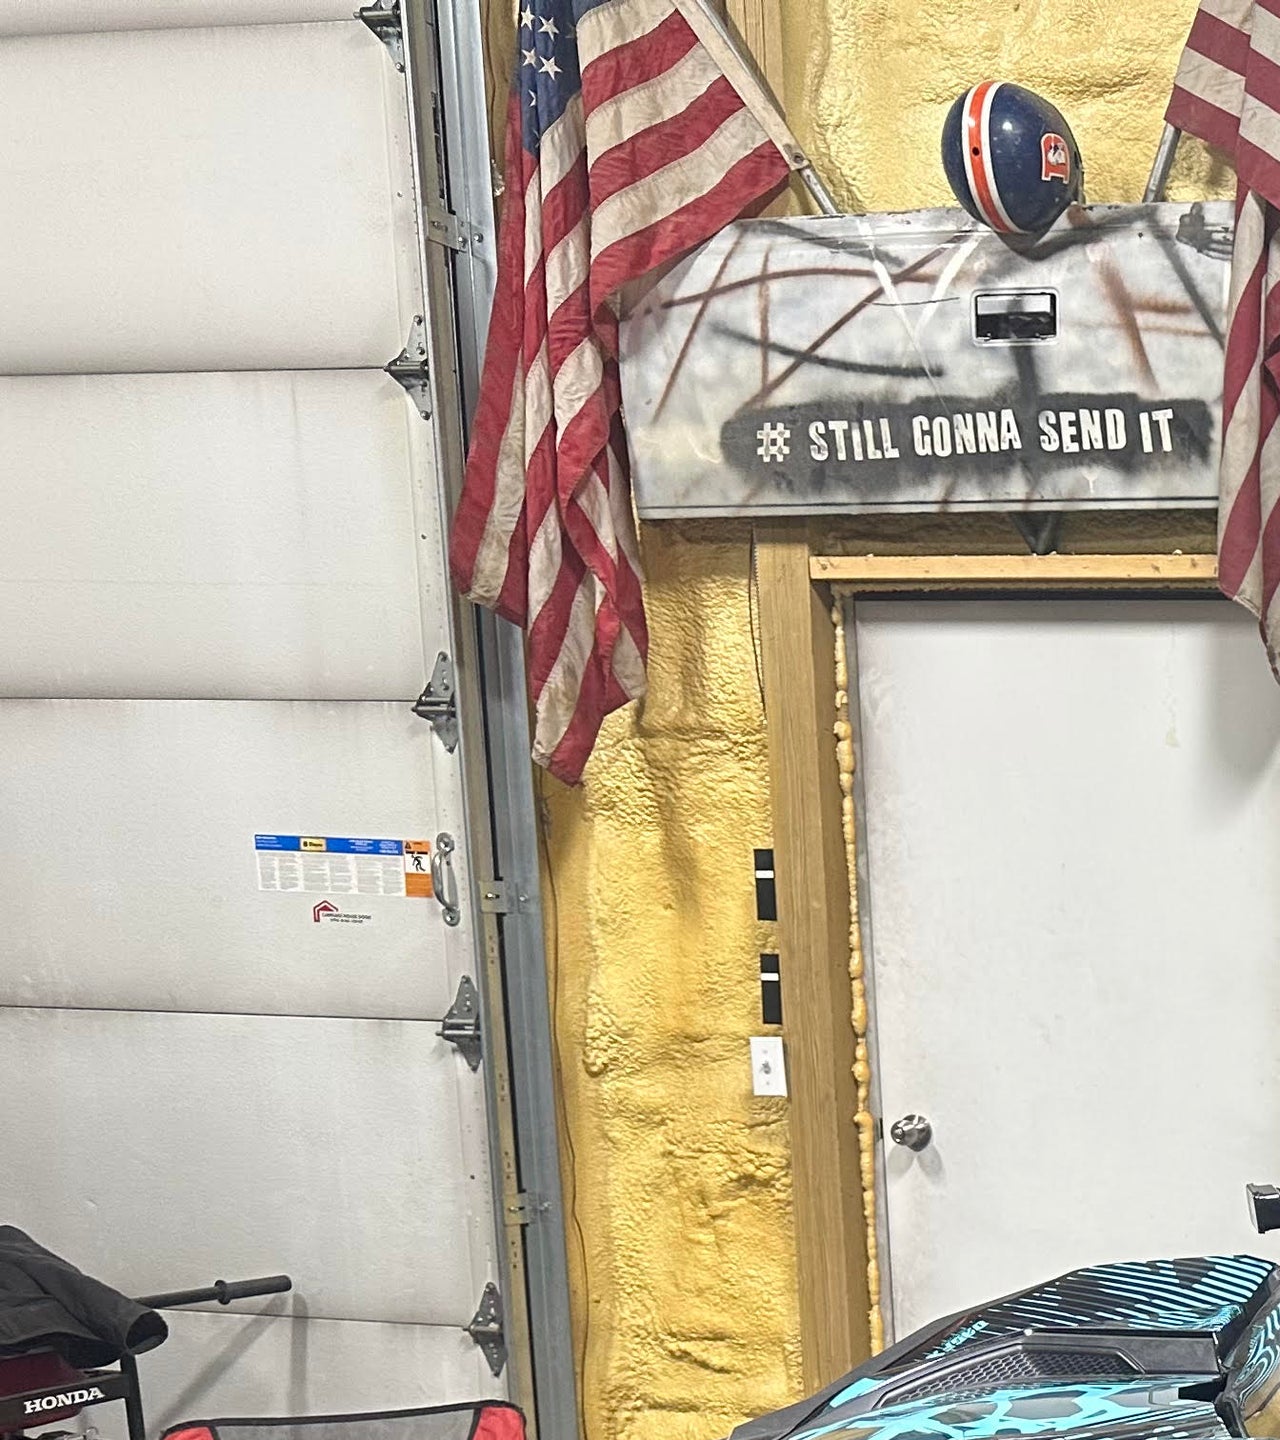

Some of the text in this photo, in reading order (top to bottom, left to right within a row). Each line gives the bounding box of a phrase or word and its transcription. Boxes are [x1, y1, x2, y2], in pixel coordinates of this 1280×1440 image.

[808, 418, 900, 461] STILL
[912, 408, 1023, 457] GONNA
[1038, 408, 1127, 453] SEND
[1139, 408, 1174, 453] IT
[23, 1386, 106, 1414] HONDA
